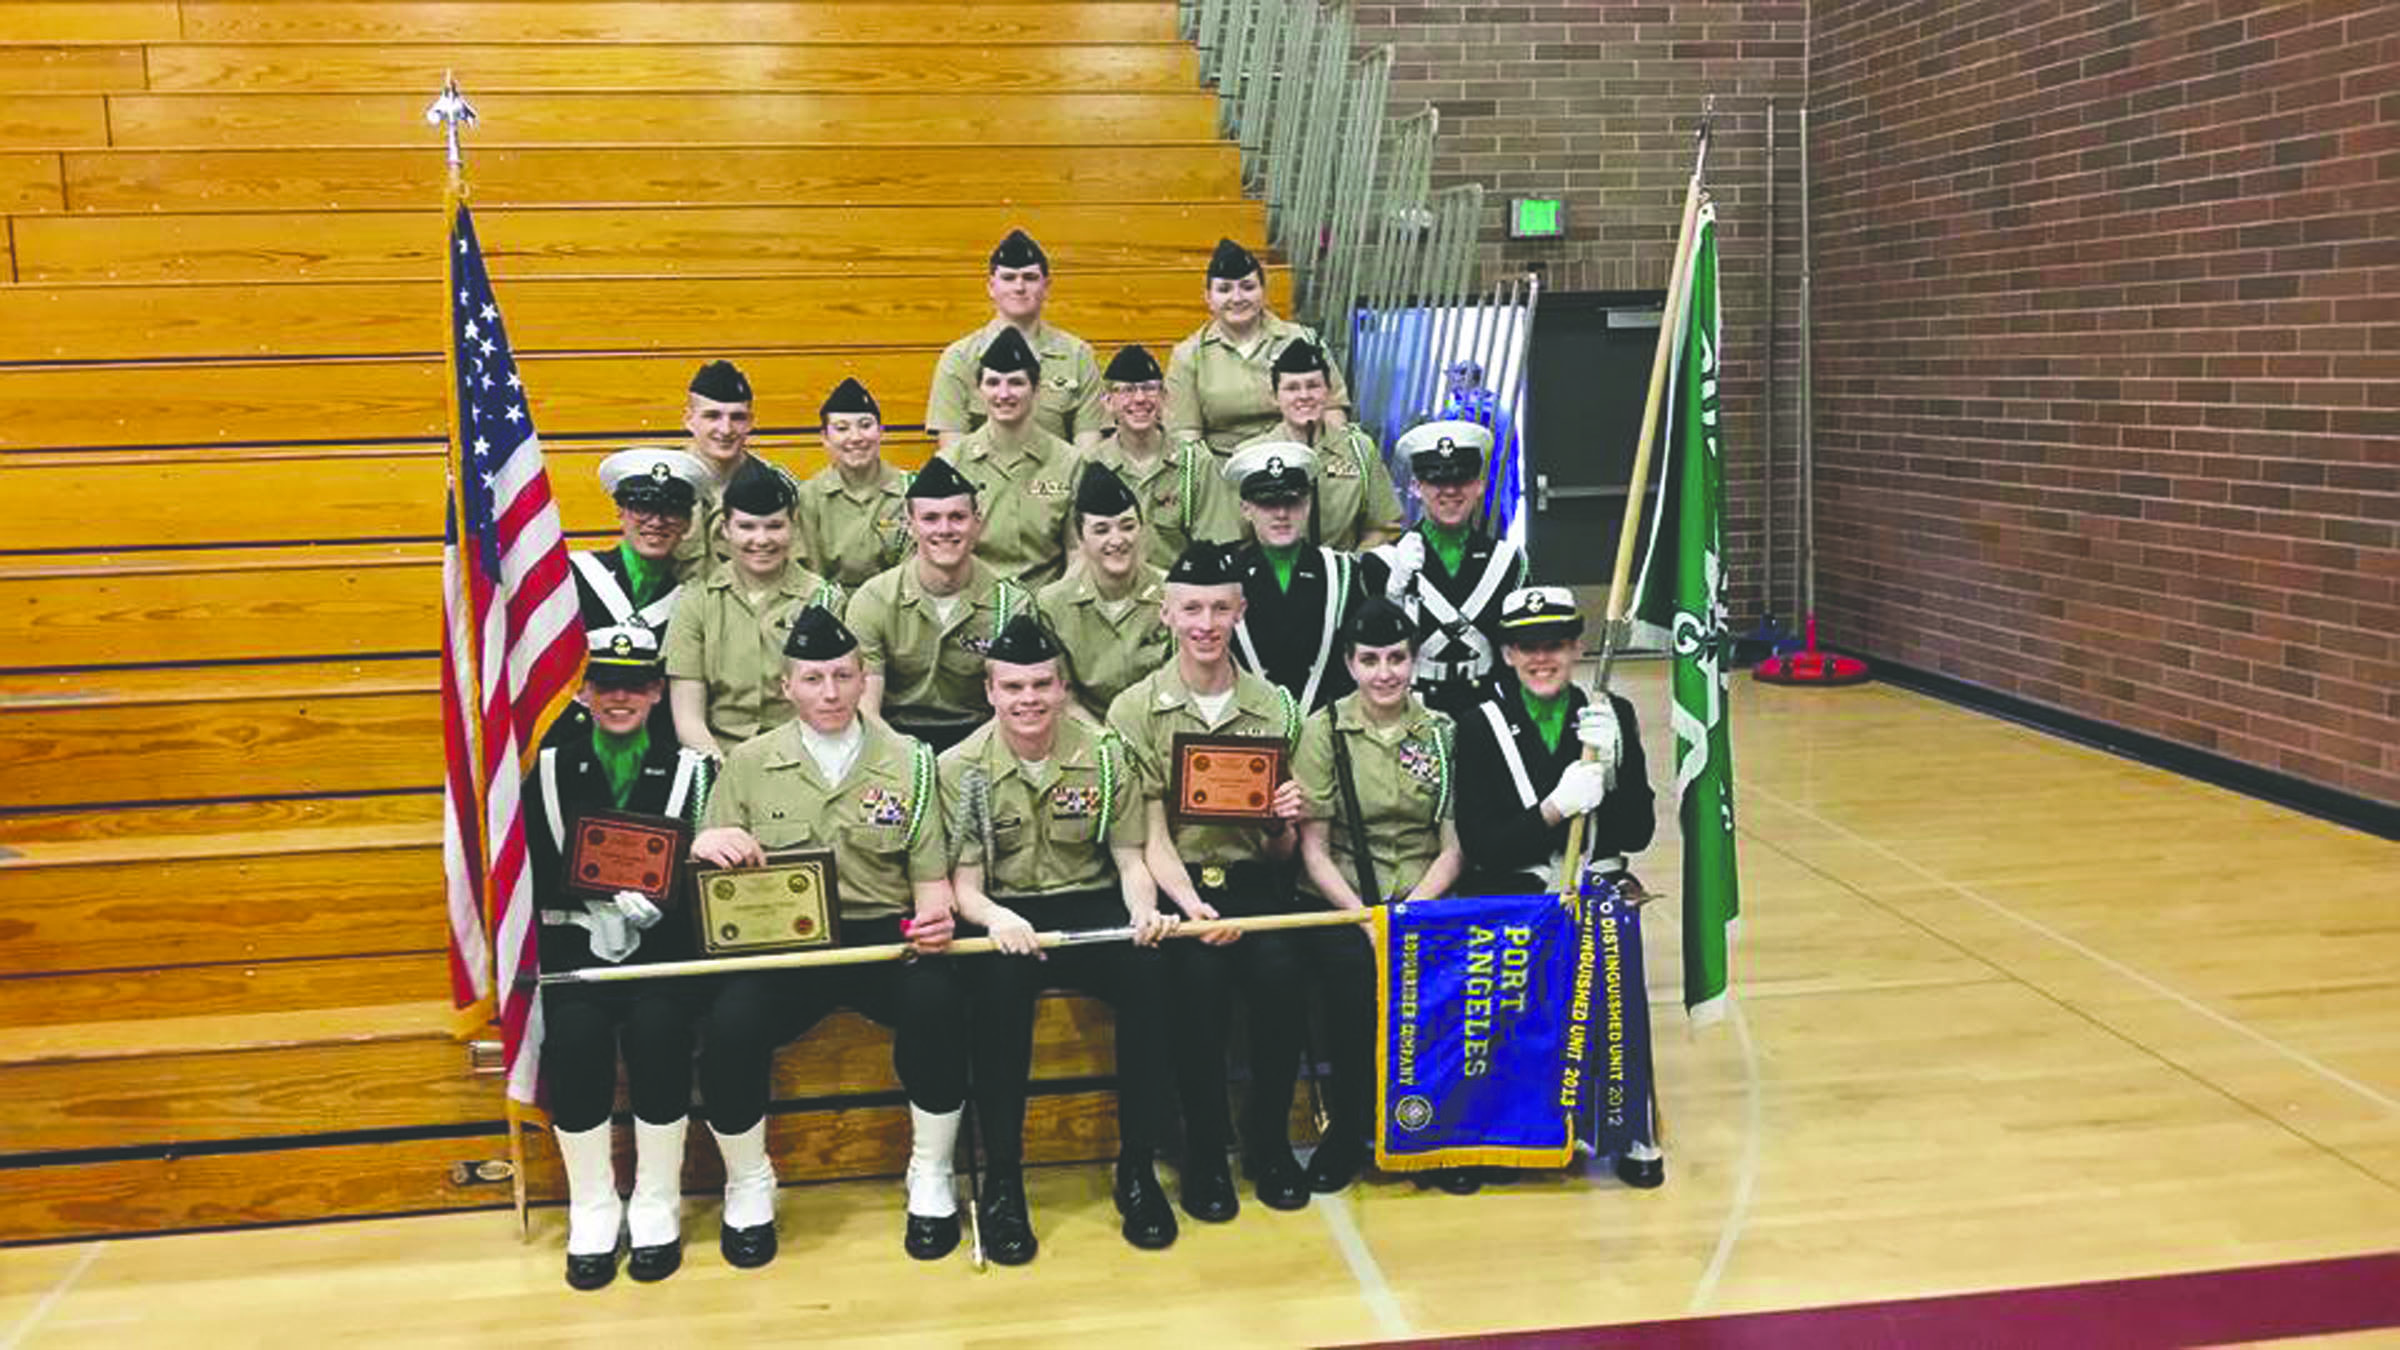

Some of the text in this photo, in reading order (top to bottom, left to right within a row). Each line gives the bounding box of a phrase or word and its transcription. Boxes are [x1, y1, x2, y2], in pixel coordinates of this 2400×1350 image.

[1463, 924, 1494, 1077] ANGELES
[1499, 925, 1531, 1012] PORT
[1559, 899, 1595, 1107] STINGUISHED UNIT 2013
[1601, 917, 1624, 1127] DISTINGUISHED UNIT 2012
[1399, 1023, 1416, 1086] COMPANY
